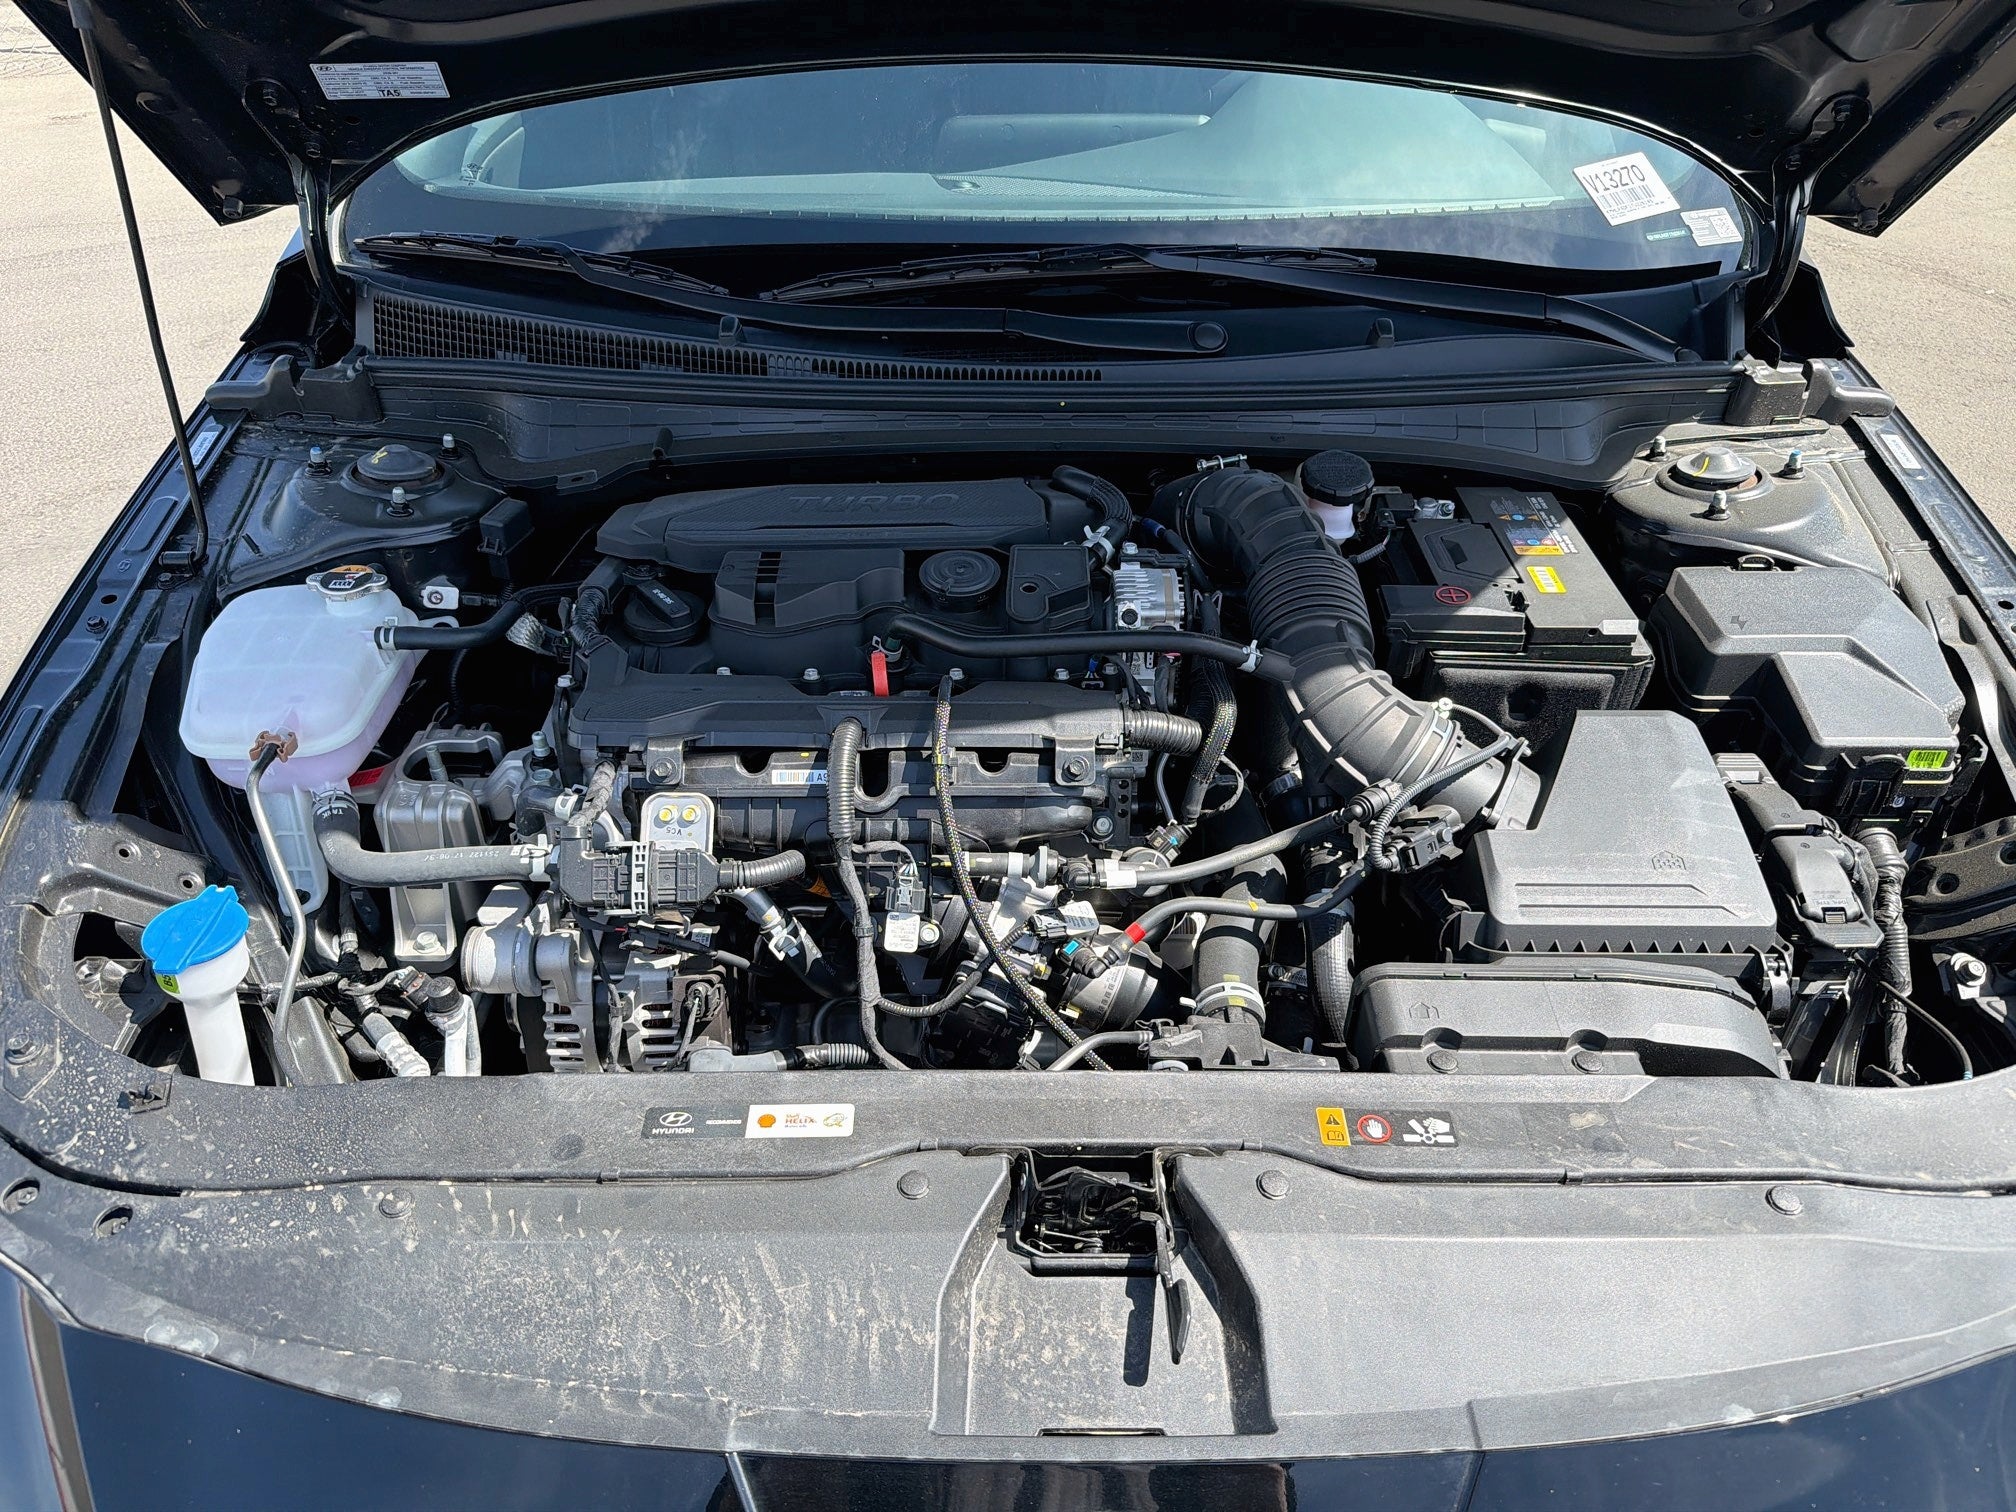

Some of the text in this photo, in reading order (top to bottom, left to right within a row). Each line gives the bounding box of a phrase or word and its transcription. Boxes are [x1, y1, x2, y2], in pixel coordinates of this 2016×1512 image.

[380, 89, 400, 97] TA5
[1583, 164, 1645, 193] V13270
[789, 494, 960, 512] TURBO
[666, 826, 682, 835] VC5
[652, 1127, 695, 1135] HYUNDAI
